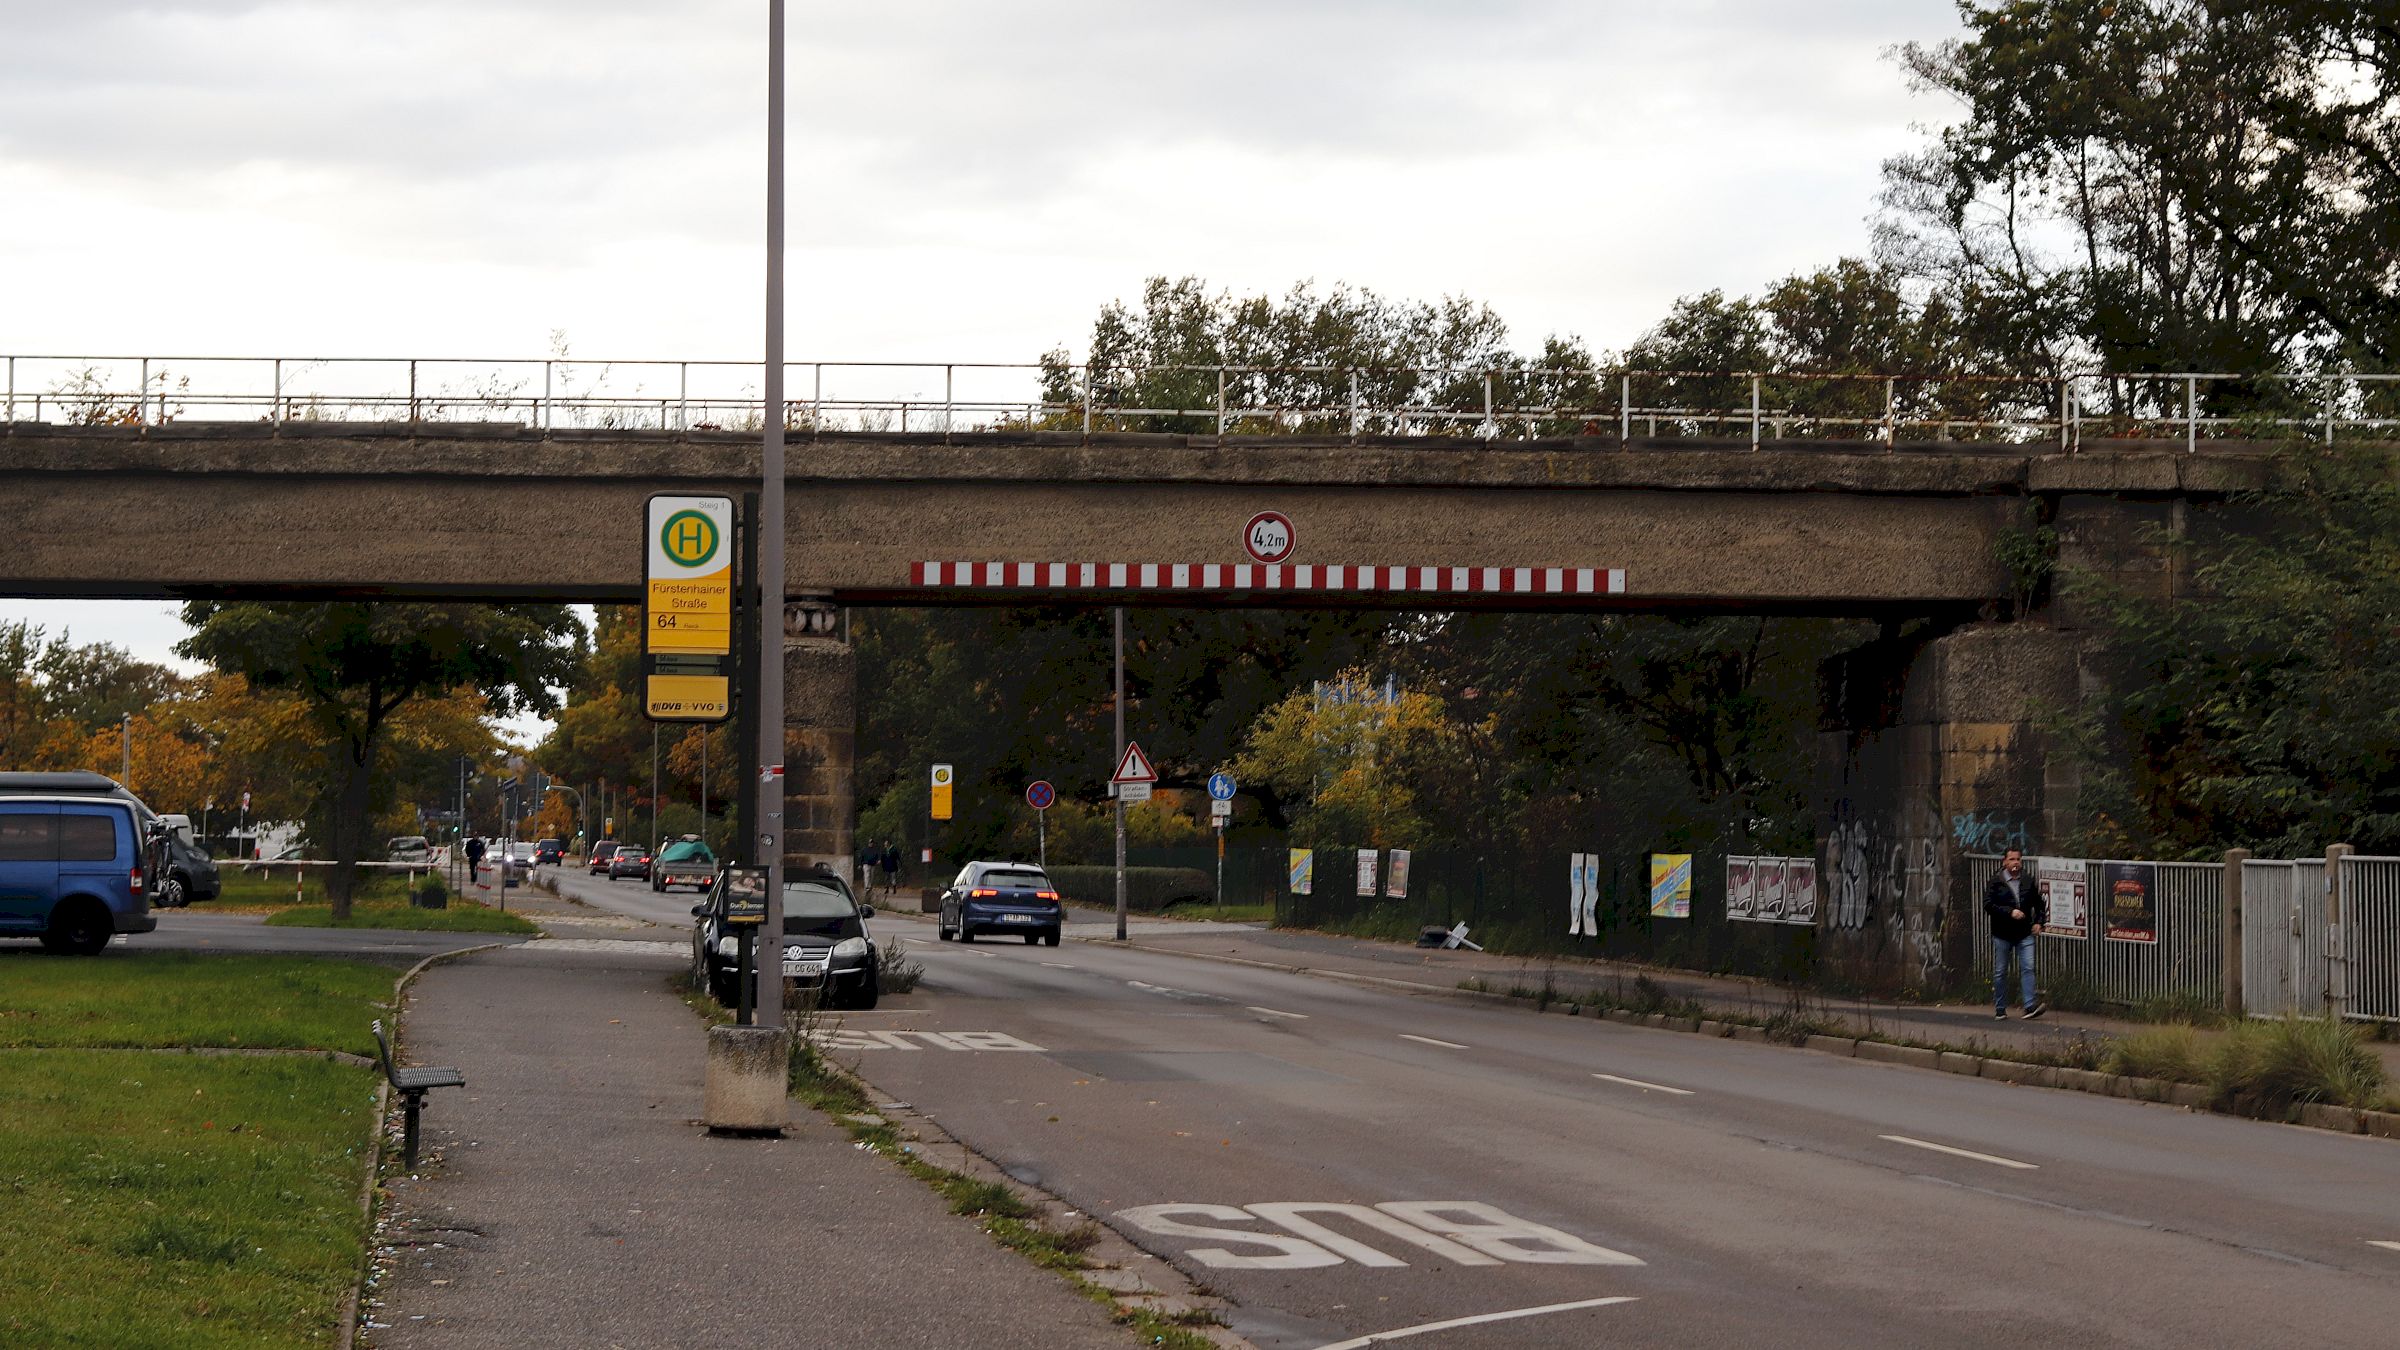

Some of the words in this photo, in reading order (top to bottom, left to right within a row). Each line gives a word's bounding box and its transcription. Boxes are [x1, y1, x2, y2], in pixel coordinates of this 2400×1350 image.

[698, 501, 719, 510] Steig
[679, 523, 702, 554] H
[653, 583, 727, 594] Fürstenhainer
[672, 598, 707, 608] Straße
[658, 615, 677, 628] 64
[661, 702, 682, 710] DVB
[692, 703, 714, 711] VVO
[800, 1029, 1048, 1051] BUS
[1112, 1200, 1648, 1270] BUS
